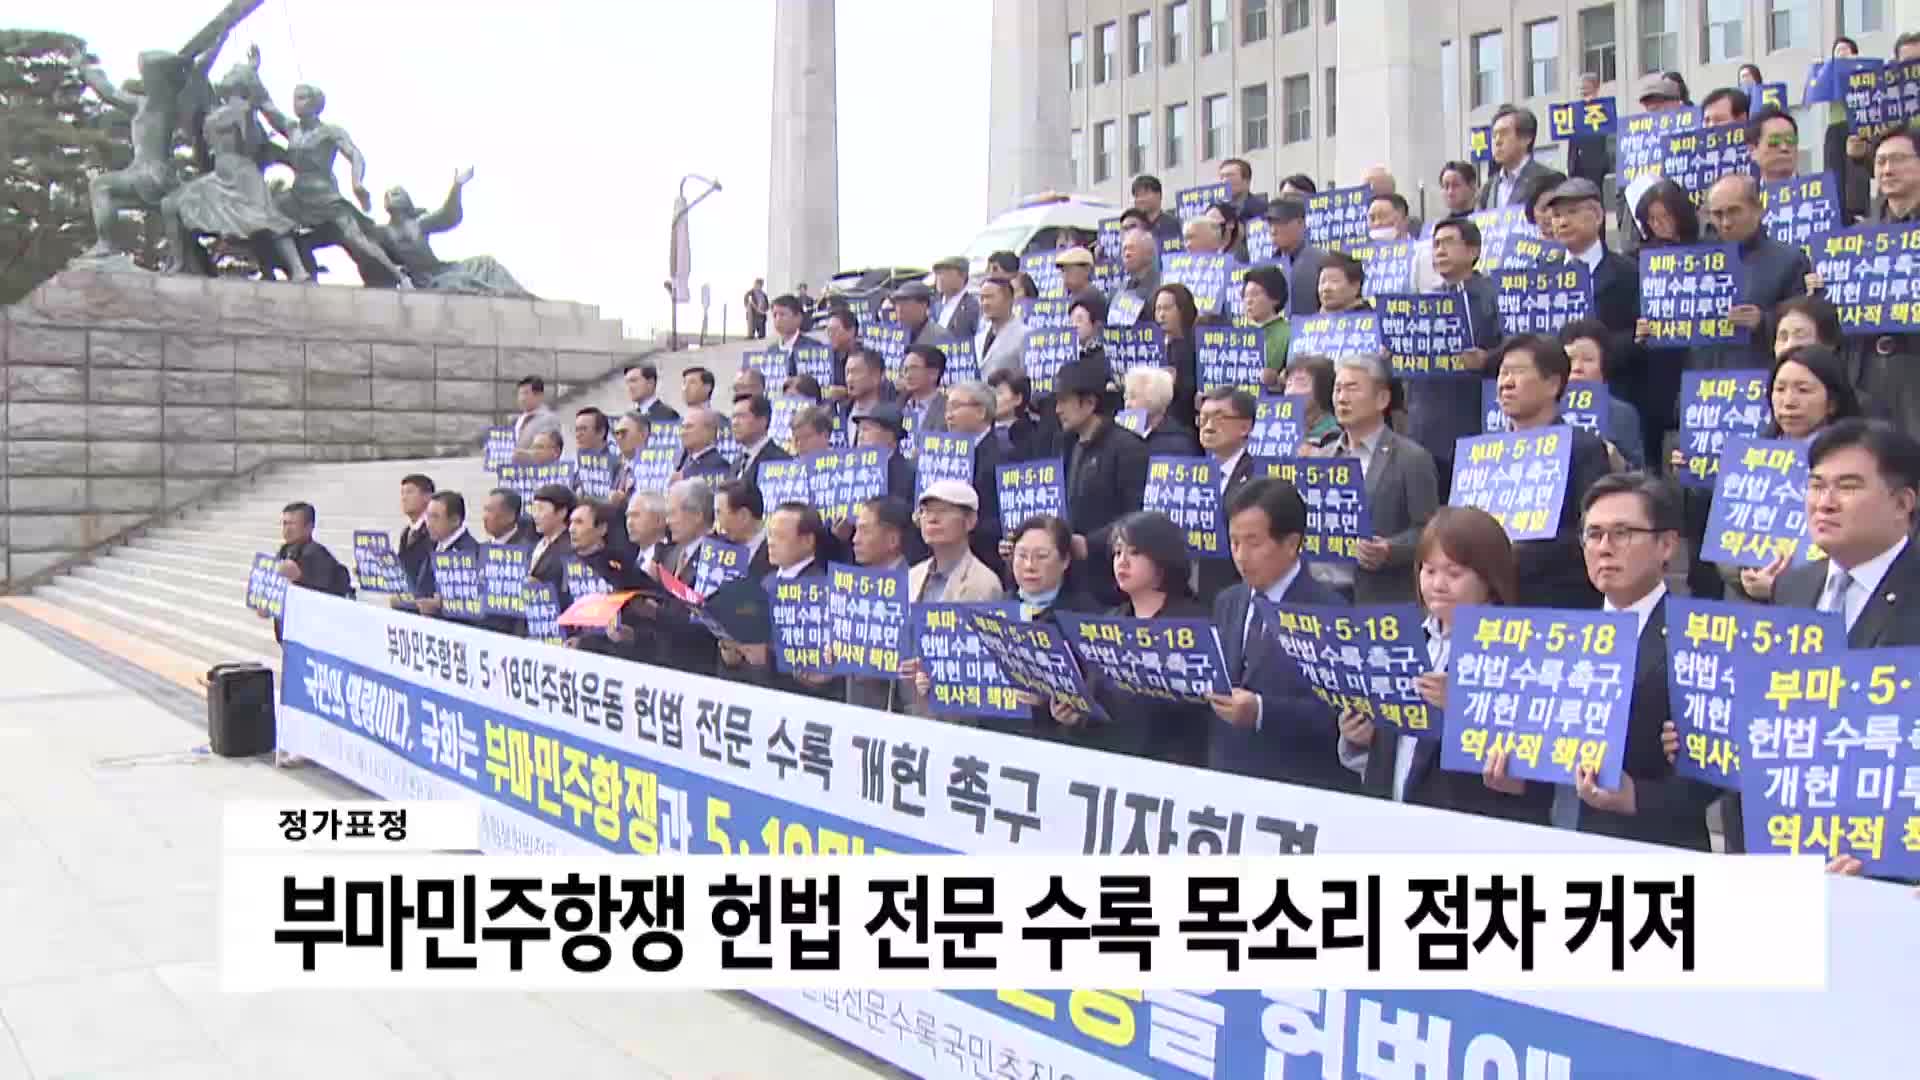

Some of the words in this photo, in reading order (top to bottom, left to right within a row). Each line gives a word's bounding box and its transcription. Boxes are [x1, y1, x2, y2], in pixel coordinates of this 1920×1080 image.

[1473, 618, 1617, 655] 부마·5·18
[1456, 652, 1509, 689] 헌법
[1509, 656, 1564, 693] 수록
[1673, 650, 1719, 691] 헌법
[1764, 665, 1912, 712] 부마·5·
[1463, 690, 1520, 728] 개헌
[1527, 695, 1613, 735] 미루면
[1684, 692, 1732, 734] 개헌
[478, 649, 625, 733] 5·18민주화운동
[633, 684, 684, 750] 헌법
[695, 698, 753, 770] 전문
[766, 716, 834, 792] 수록
[851, 735, 930, 818] 개헌
[946, 755, 1041, 844] 촉구
[1749, 715, 1817, 760] 헌법
[1823, 714, 1902, 760] 수록
[485, 719, 693, 854] 부마민주항쟁과
[1764, 764, 1840, 809] 개헌
[1767, 813, 1885, 860] 역사적
